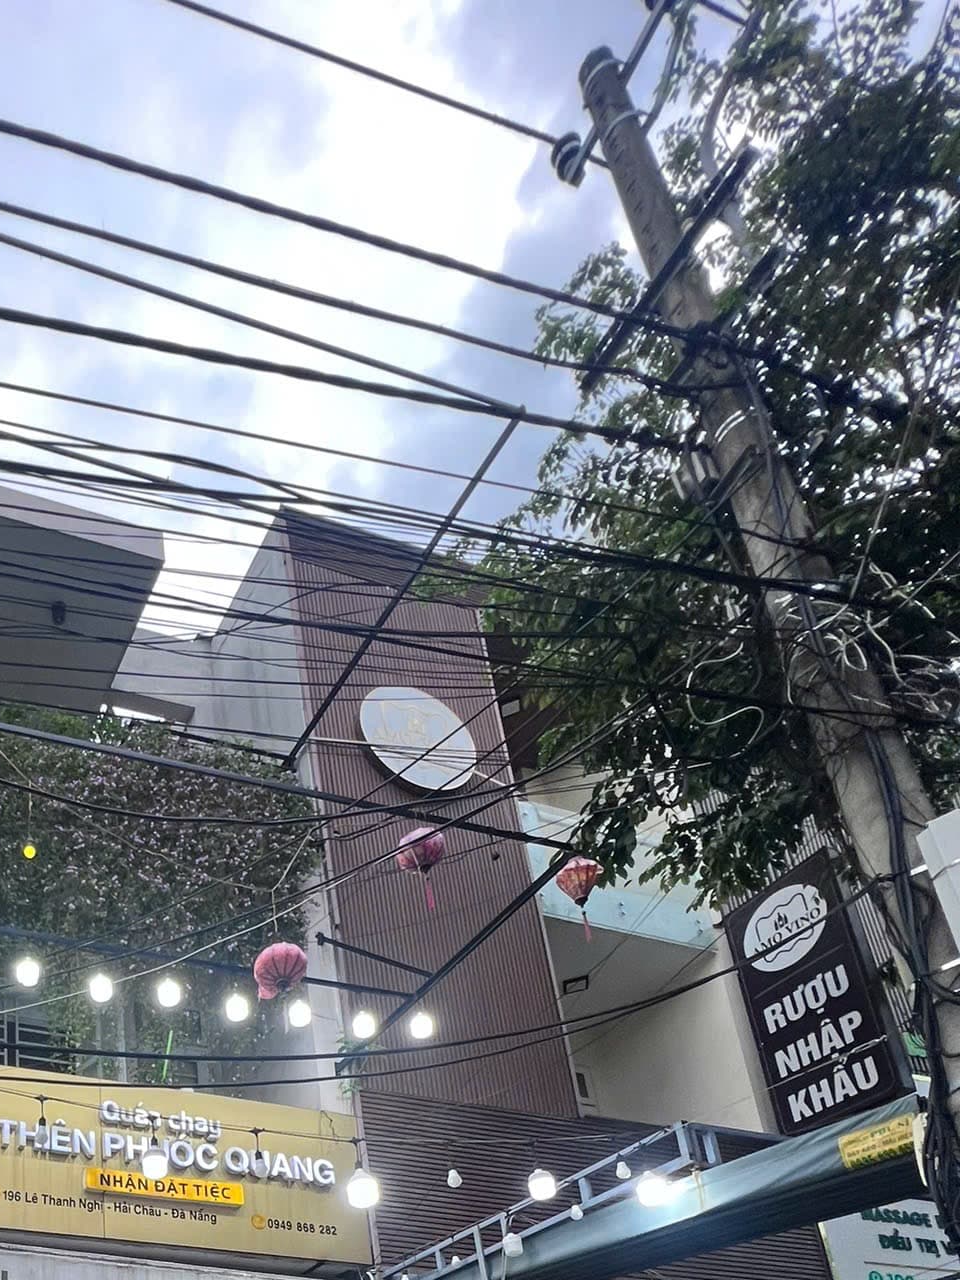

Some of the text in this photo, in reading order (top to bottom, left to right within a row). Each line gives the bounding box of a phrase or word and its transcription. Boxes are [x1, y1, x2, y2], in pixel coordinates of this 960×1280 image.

[762, 963, 851, 1034] RƯỢU
[774, 1009, 863, 1078] NHẬP
[101, 1100, 222, 1141] Quán chay
[99, 1173, 233, 1201] NHẬN ĐẶT TIỆC
[3, 1190, 21, 1201] 196
[25, 1191, 38, 1204] Lê
[42, 1193, 76, 1207] Thanh
[114, 1201, 132, 1215] Hải
[134, 1203, 162, 1218] Châu
[172, 1208, 186, 1220] Đà
[267, 1218, 338, 1236] 0949 868 282
